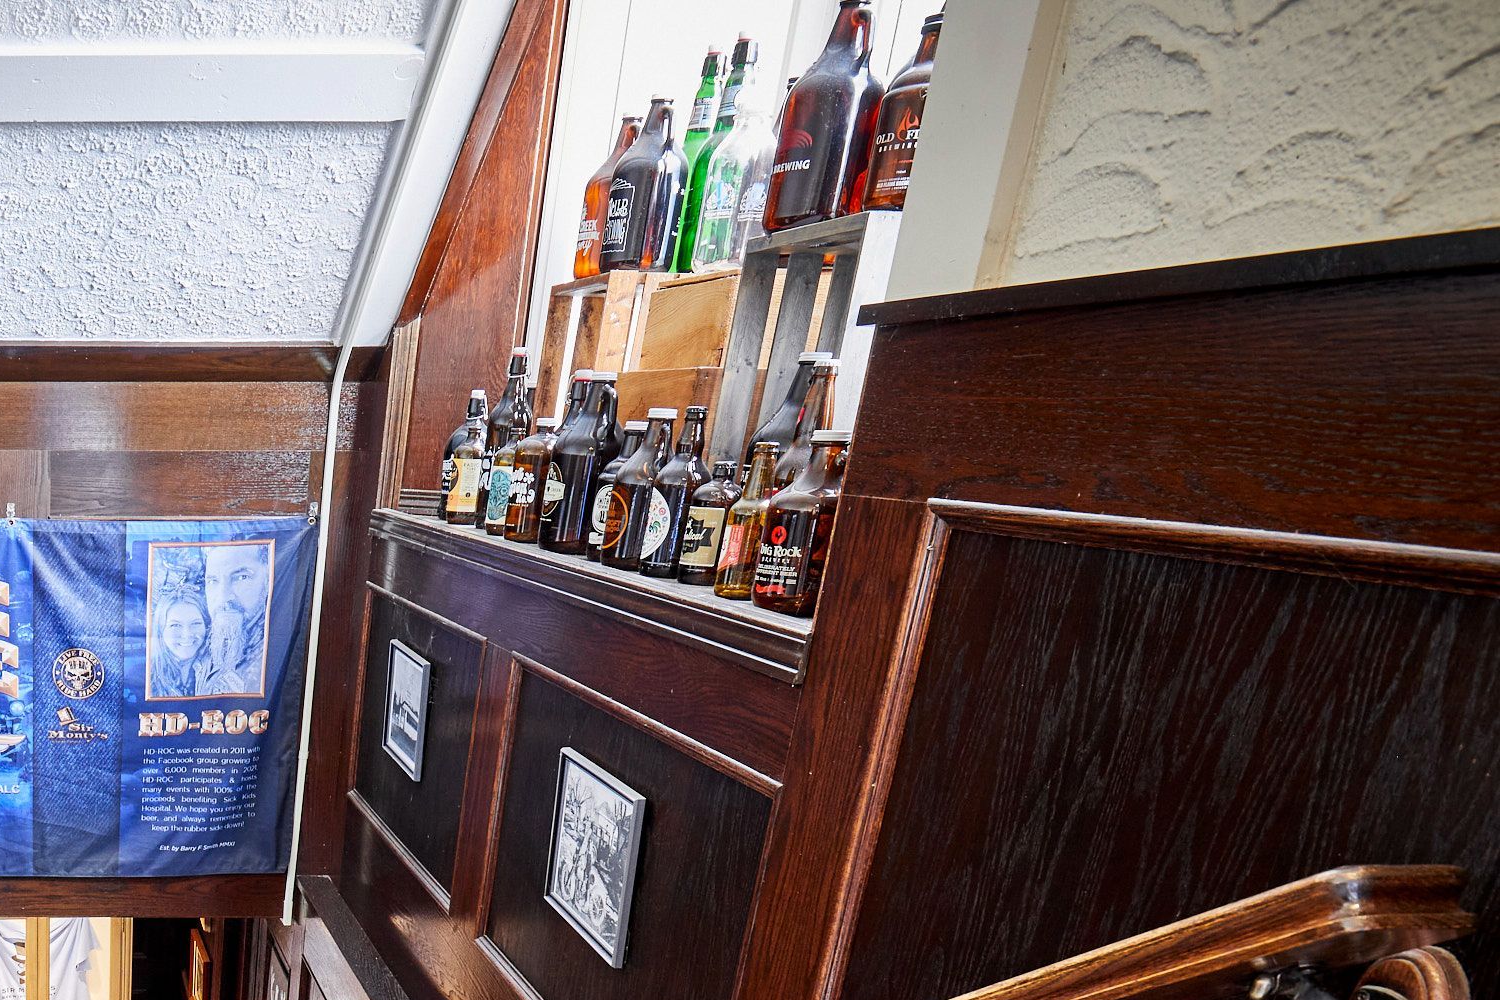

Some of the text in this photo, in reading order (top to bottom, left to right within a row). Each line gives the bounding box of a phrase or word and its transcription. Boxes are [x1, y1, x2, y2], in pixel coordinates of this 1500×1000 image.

[876, 132, 895, 145] OLD
[68, 723, 93, 731] Sir
[138, 709, 270, 737] HD-ROC
[48, 730, 108, 742] Monty's
[180, 776, 222, 784] participates
[214, 786, 233, 794] 100%
[141, 795, 175, 803] proceeds
[181, 796, 217, 804] benefiting
[223, 795, 237, 803] Sick
[225, 805, 242, 813] enjoy
[181, 815, 206, 823] always
[209, 813, 243, 822] remember
[151, 824, 169, 832] keep
[223, 821, 245, 829] down!
